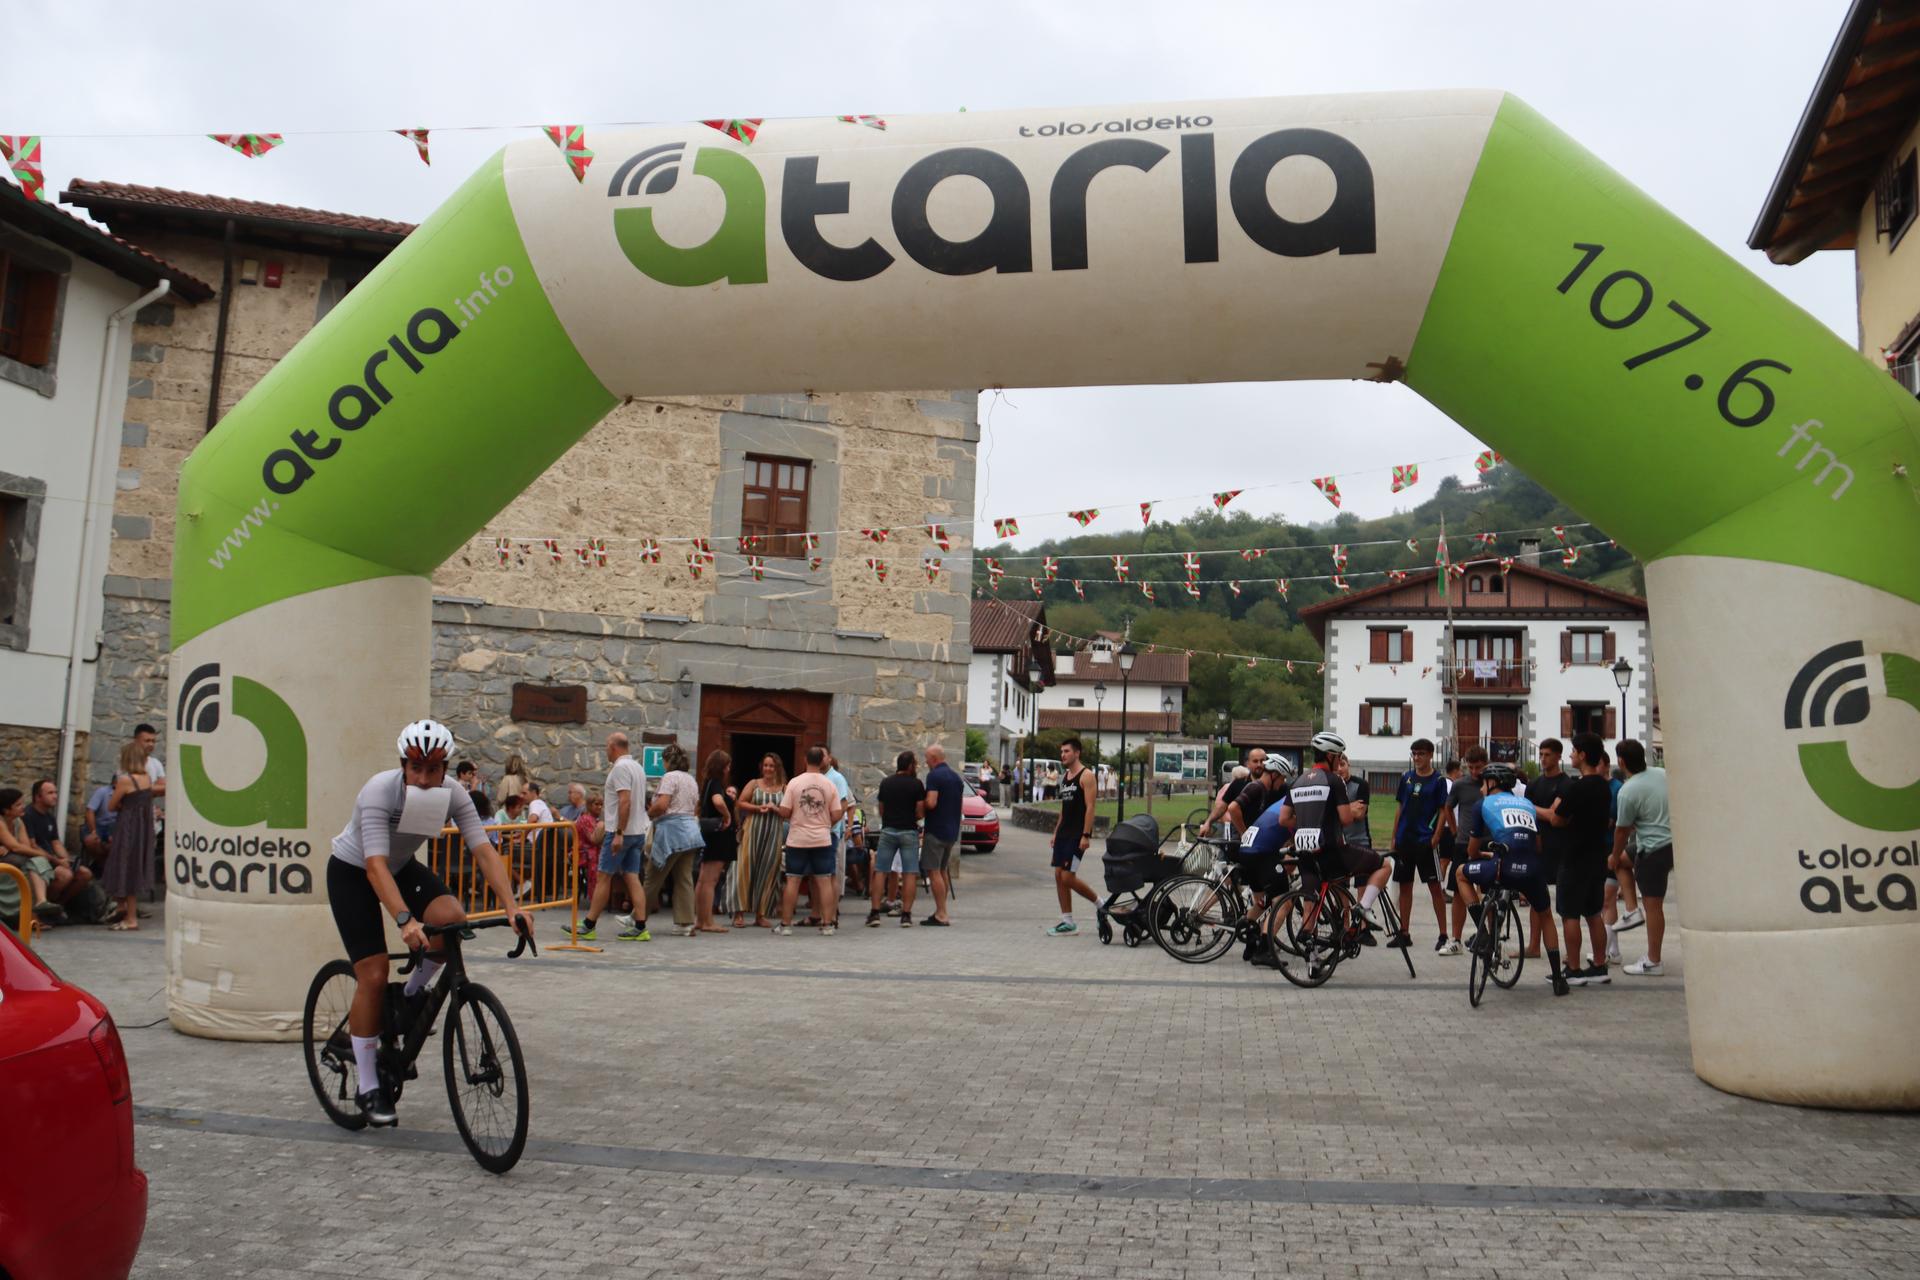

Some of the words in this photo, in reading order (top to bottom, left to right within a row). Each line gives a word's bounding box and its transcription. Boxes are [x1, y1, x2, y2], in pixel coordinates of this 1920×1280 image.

[1018, 115, 1214, 138] tolosaldeko
[607, 127, 1377, 288] ataria
[1556, 242, 1793, 428] 107.6
[1776, 418, 1855, 501] fm
[1506, 813, 1535, 829] 062
[174, 830, 312, 858] tolosaldeko
[1296, 834, 1317, 850] 033
[1798, 840, 1920, 870] tolosal
[174, 854, 313, 894] ataria
[1800, 873, 1919, 914] ata
